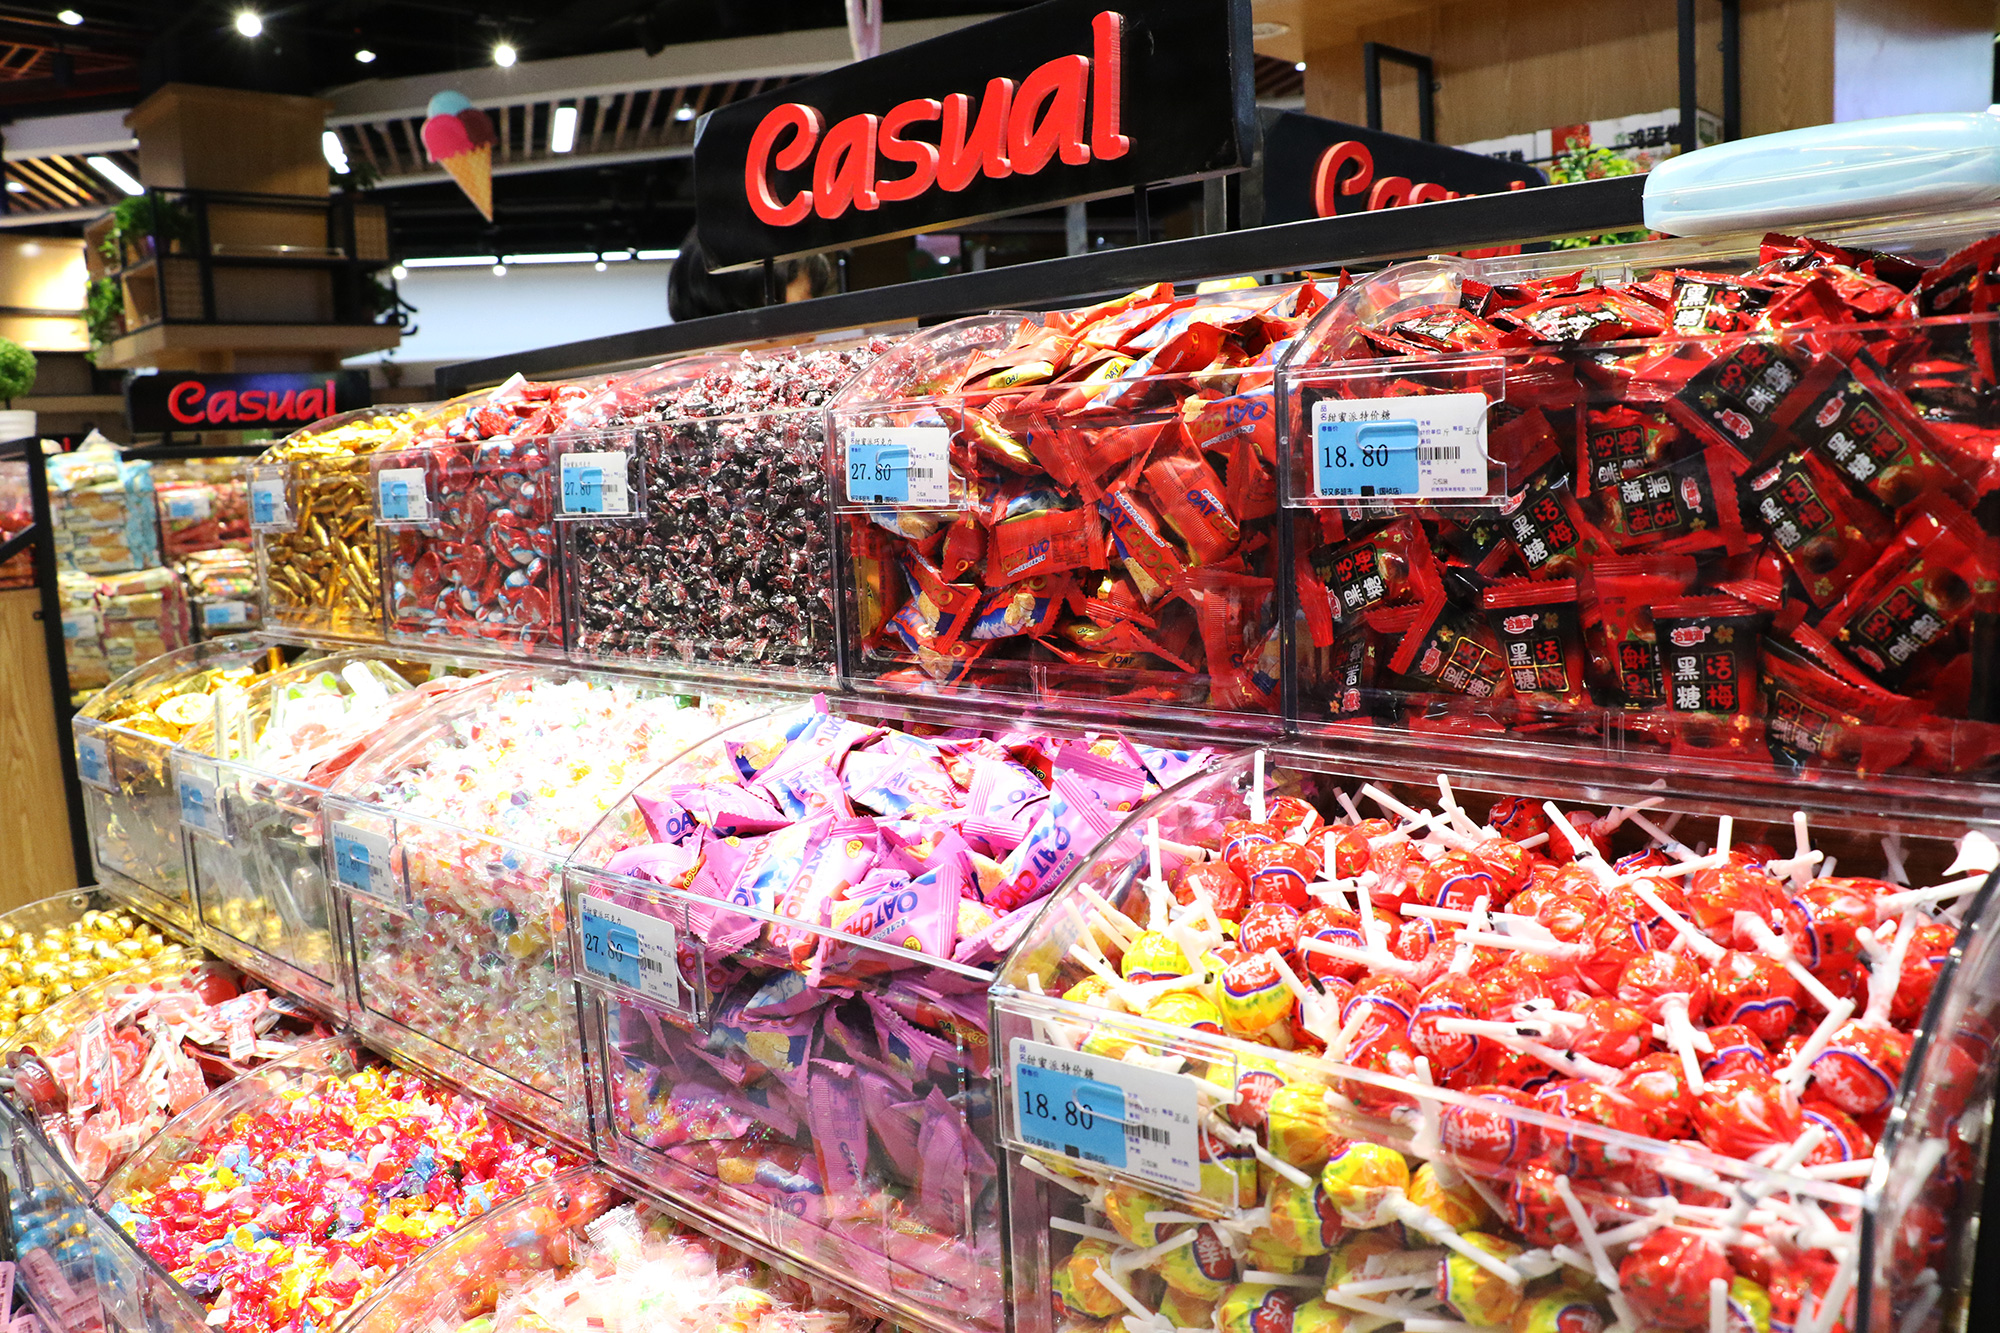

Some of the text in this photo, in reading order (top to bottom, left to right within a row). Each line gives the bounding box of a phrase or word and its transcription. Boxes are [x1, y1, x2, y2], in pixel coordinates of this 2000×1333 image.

[745, 10, 1131, 226] Casual
[167, 379, 336, 424] Casual
[1225, 401, 1269, 428] OAT
[851, 463, 892, 481] 27.80
[1323, 444, 1389, 468] 18.80
[565, 482, 591, 496] 27.80
[1186, 489, 1219, 516] OAT
[1103, 491, 1134, 530] OAT
[1674, 655, 1702, 709] 黑糖
[873, 890, 919, 930] OAT
[585, 932, 624, 963] 27.80
[1024, 1091, 1094, 1130] 18.80
